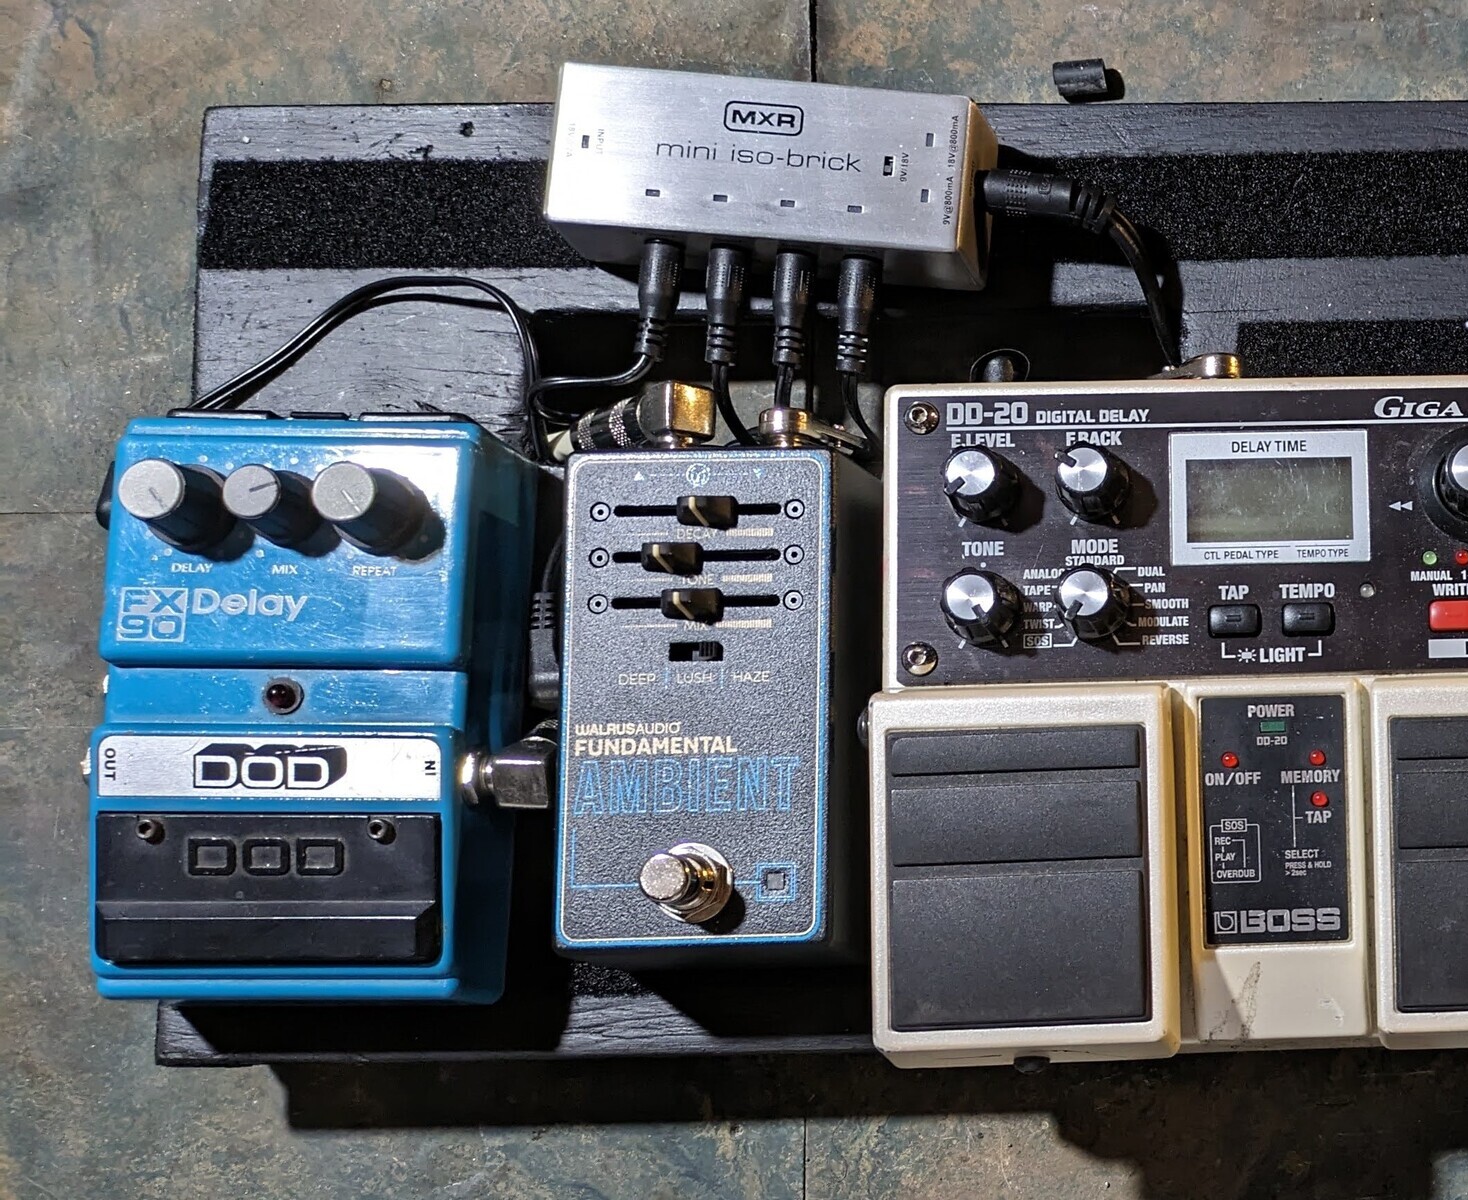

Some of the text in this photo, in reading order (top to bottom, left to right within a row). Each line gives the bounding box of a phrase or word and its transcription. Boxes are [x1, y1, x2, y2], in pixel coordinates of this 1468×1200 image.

[730, 107, 796, 130] MXR
[656, 140, 862, 174] mini iso-brick
[900, 152, 909, 182] 9V/18V
[1374, 395, 1464, 418] GIGA
[946, 402, 1150, 425] DD-20 DIGITAL DELAY
[951, 433, 1015, 448] E.LEVEL
[1231, 439, 1307, 453] DELAY TIME
[676, 528, 717, 539] DECAY
[961, 541, 1004, 556] TONE
[1071, 538, 1119, 554] MODE
[1204, 549, 1279, 560] CTL PEDAL TYPE
[1297, 548, 1349, 558] TEMPO TYPE
[1065, 555, 1125, 566] STANDARD
[170, 563, 214, 574] DELAY
[271, 563, 299, 575] MIX
[352, 565, 397, 576] REPEAT
[1137, 566, 1166, 577] DUAL
[1460, 569, 1467, 580] 1
[681, 574, 715, 585] TONE
[1410, 570, 1453, 582] MANUAL
[1023, 585, 1051, 596] TAPE
[1144, 583, 1166, 593] PAN
[1218, 585, 1249, 600] TAP
[1279, 583, 1336, 599] TEMPO
[122, 589, 186, 614] FX
[192, 588, 308, 620] Delay
[1023, 602, 1053, 613] WARP
[1144, 599, 1189, 609] SMOOTH
[119, 615, 183, 639] 90
[683, 621, 708, 631] MIX
[1023, 619, 1054, 629] TWIST
[1138, 617, 1189, 628] MODULATE
[1026, 635, 1050, 646] SOS
[1141, 635, 1189, 646] REVERSE
[1259, 647, 1306, 663] LIGHT
[618, 672, 656, 685] DEEP
[676, 671, 714, 684] LUSH
[733, 670, 770, 683] HAZE
[1247, 704, 1295, 718] POWER
[574, 735, 738, 757] FUNDAMENTAL
[1256, 735, 1288, 746] DD-20
[104, 748, 116, 781] OUT
[194, 752, 336, 790] DOD
[424, 759, 436, 776] IN
[1205, 771, 1262, 786] ON/OFF
[1280, 769, 1341, 784] MEMORY
[573, 756, 800, 817] AMBIENT
[1305, 810, 1332, 824] TAP
[1224, 821, 1244, 830] SOS
[1214, 836, 1231, 846] REC
[187, 837, 345, 876] DOD
[1215, 852, 1235, 862] PLAY
[1285, 849, 1319, 859] SELECT
[1285, 860, 1332, 869] PRESS & HOLD
[1216, 869, 1256, 878] OVERDUB
[1240, 907, 1341, 934] BOSS
